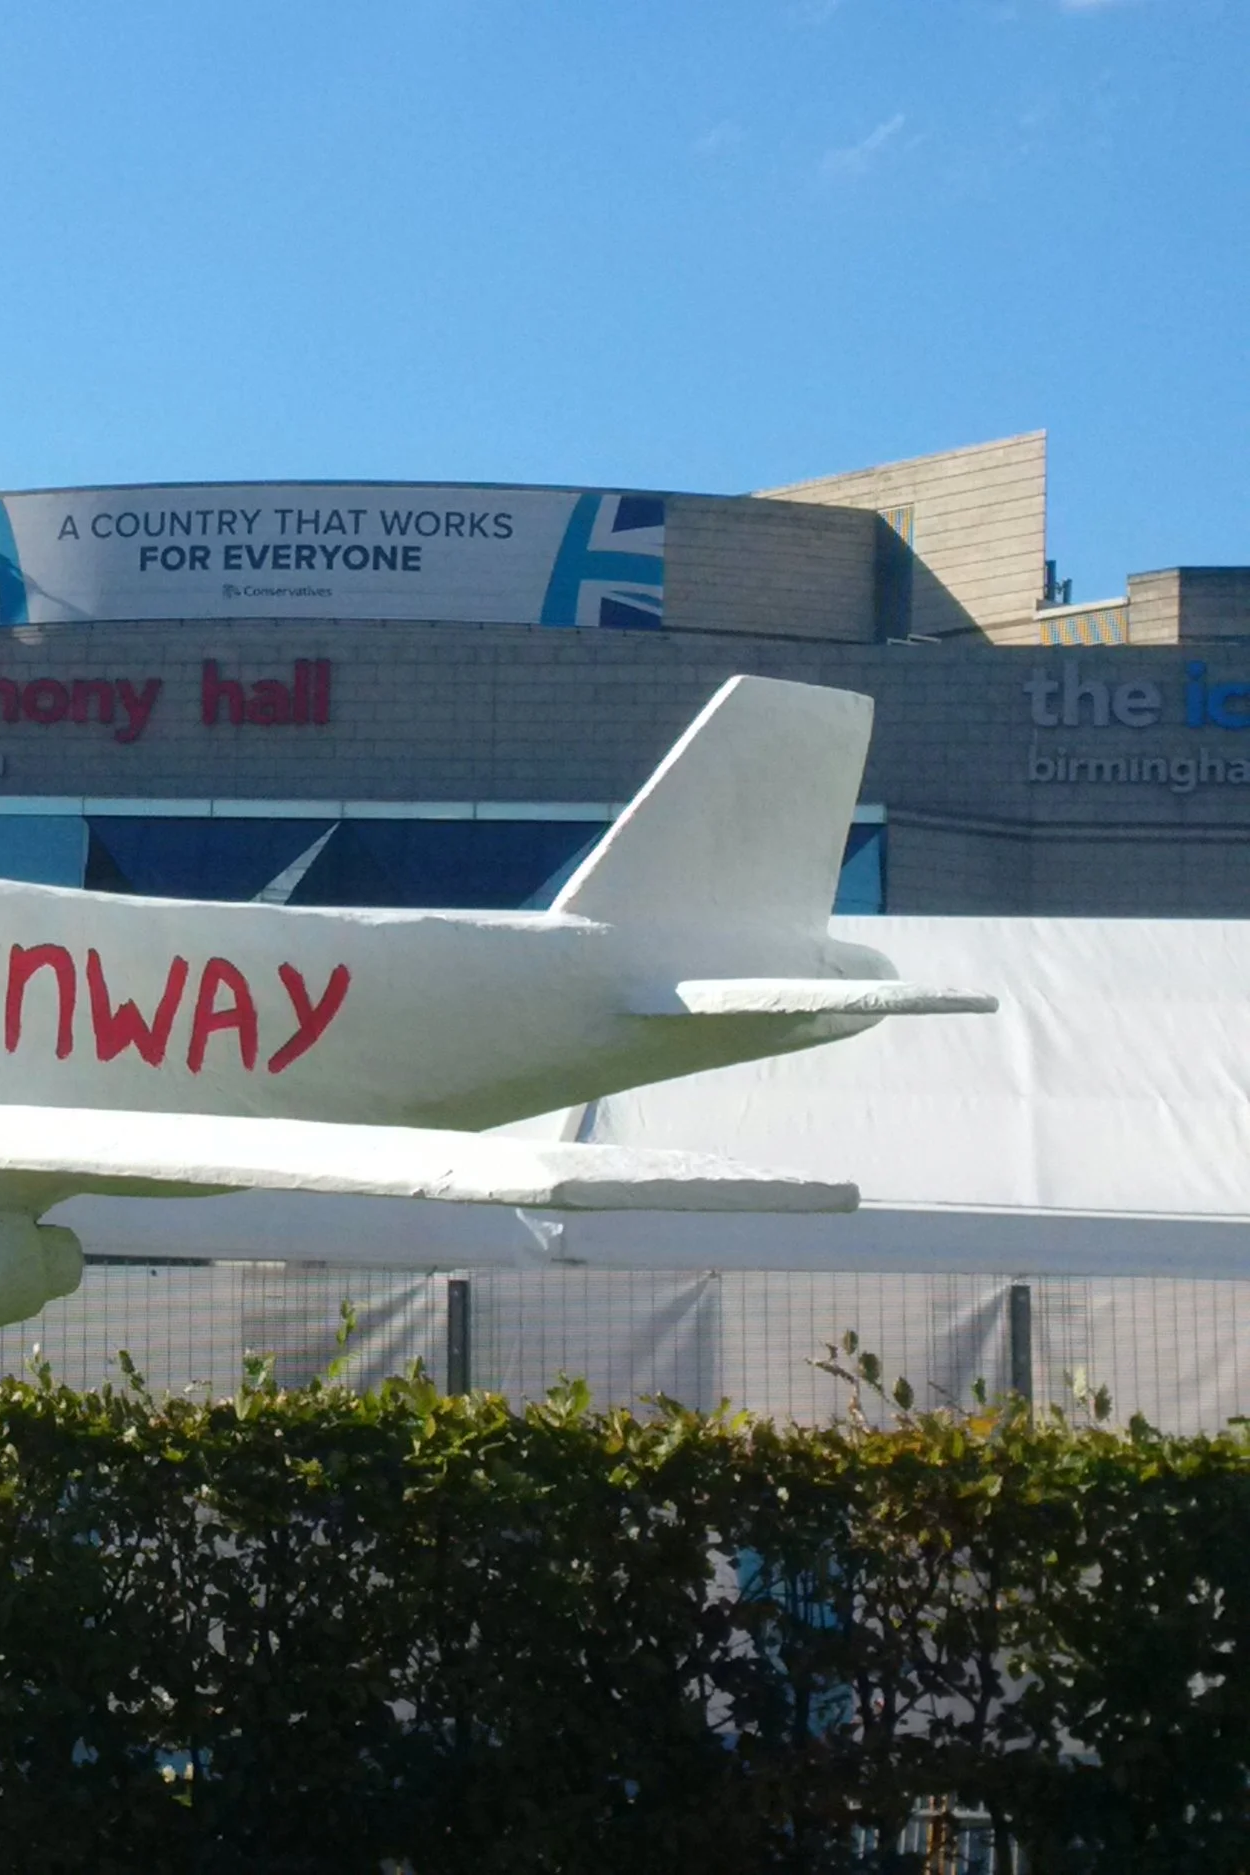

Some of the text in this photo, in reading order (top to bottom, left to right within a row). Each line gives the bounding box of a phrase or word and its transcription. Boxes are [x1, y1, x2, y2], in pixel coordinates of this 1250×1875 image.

[58, 509, 514, 541] A COUNTRY THAT WORKS
[139, 544, 423, 572] FOR EVERYONE
[243, 584, 333, 599] Conservatives
[202, 657, 332, 726] hall
[1023, 659, 1161, 728] the
